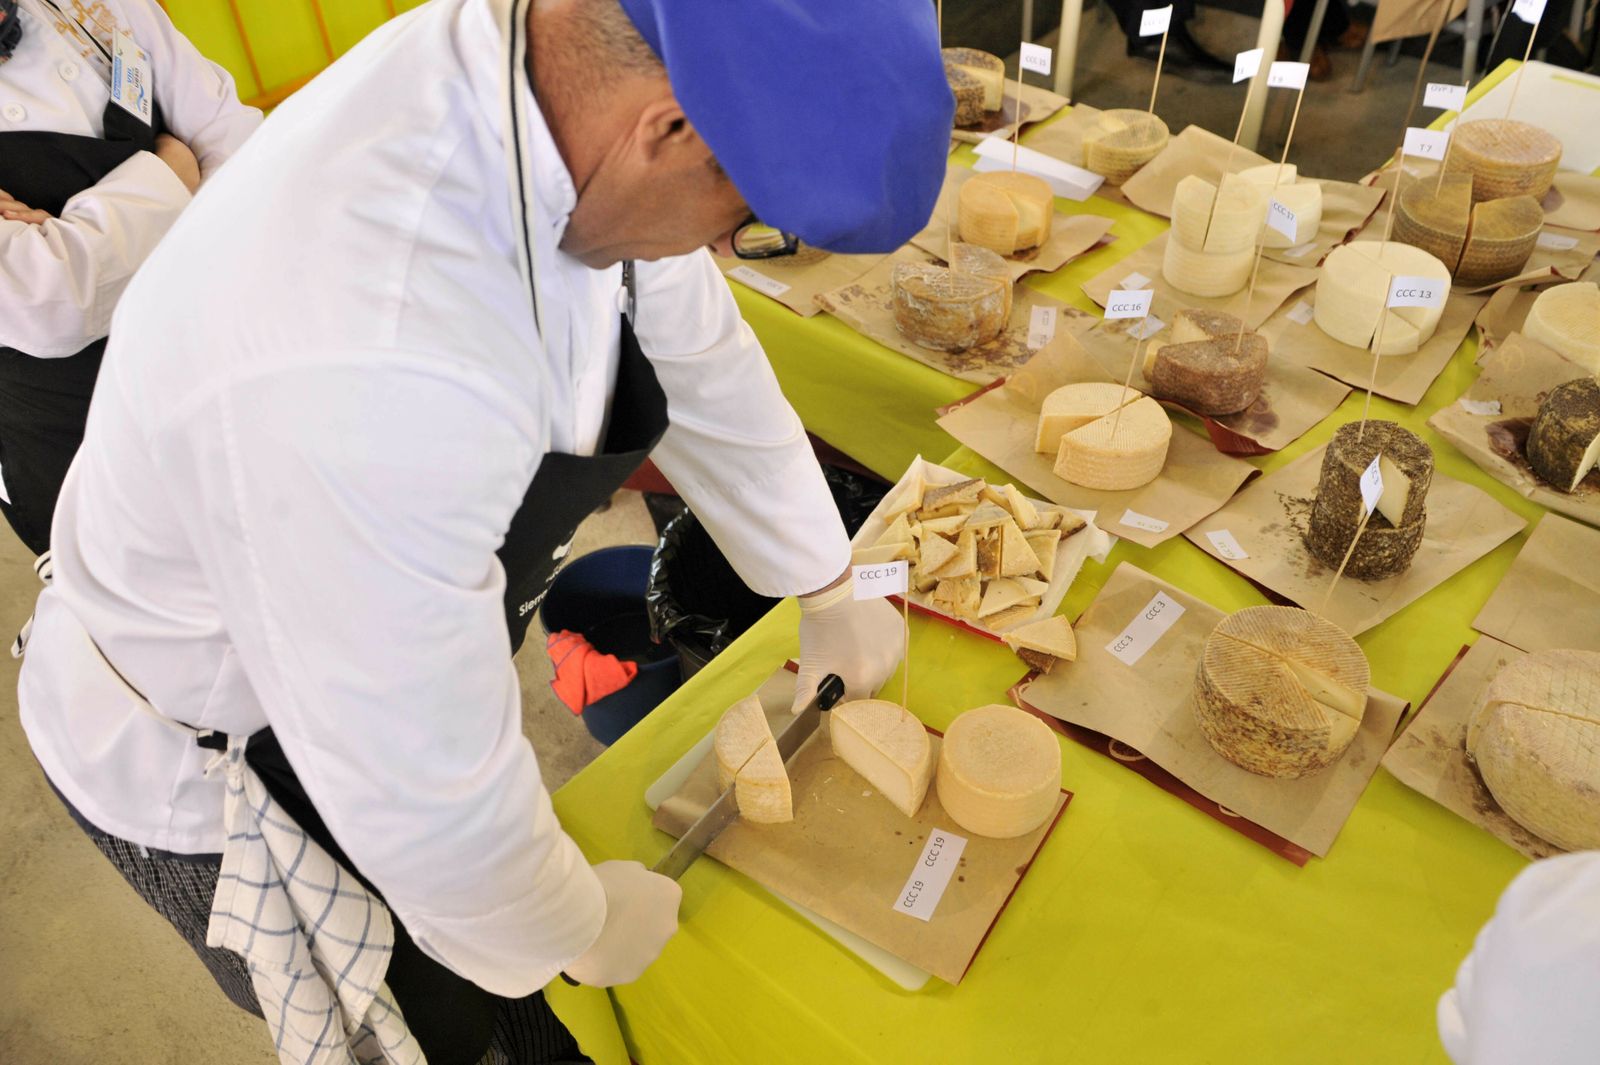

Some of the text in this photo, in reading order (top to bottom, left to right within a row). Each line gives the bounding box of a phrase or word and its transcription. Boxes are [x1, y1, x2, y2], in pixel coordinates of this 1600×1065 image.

[1025, 55, 1038, 65] CCC
[1273, 202, 1295, 221] CCC 17
[1396, 289, 1432, 299] CCC 13
[1112, 303, 1141, 312] CCC 16
[859, 567, 897, 580] CCC 19
[1145, 600, 1166, 620] CCC 3
[1113, 634, 1133, 653] CCC 3
[925, 836, 945, 867] CCC 19
[903, 880, 924, 908] CCC 19
